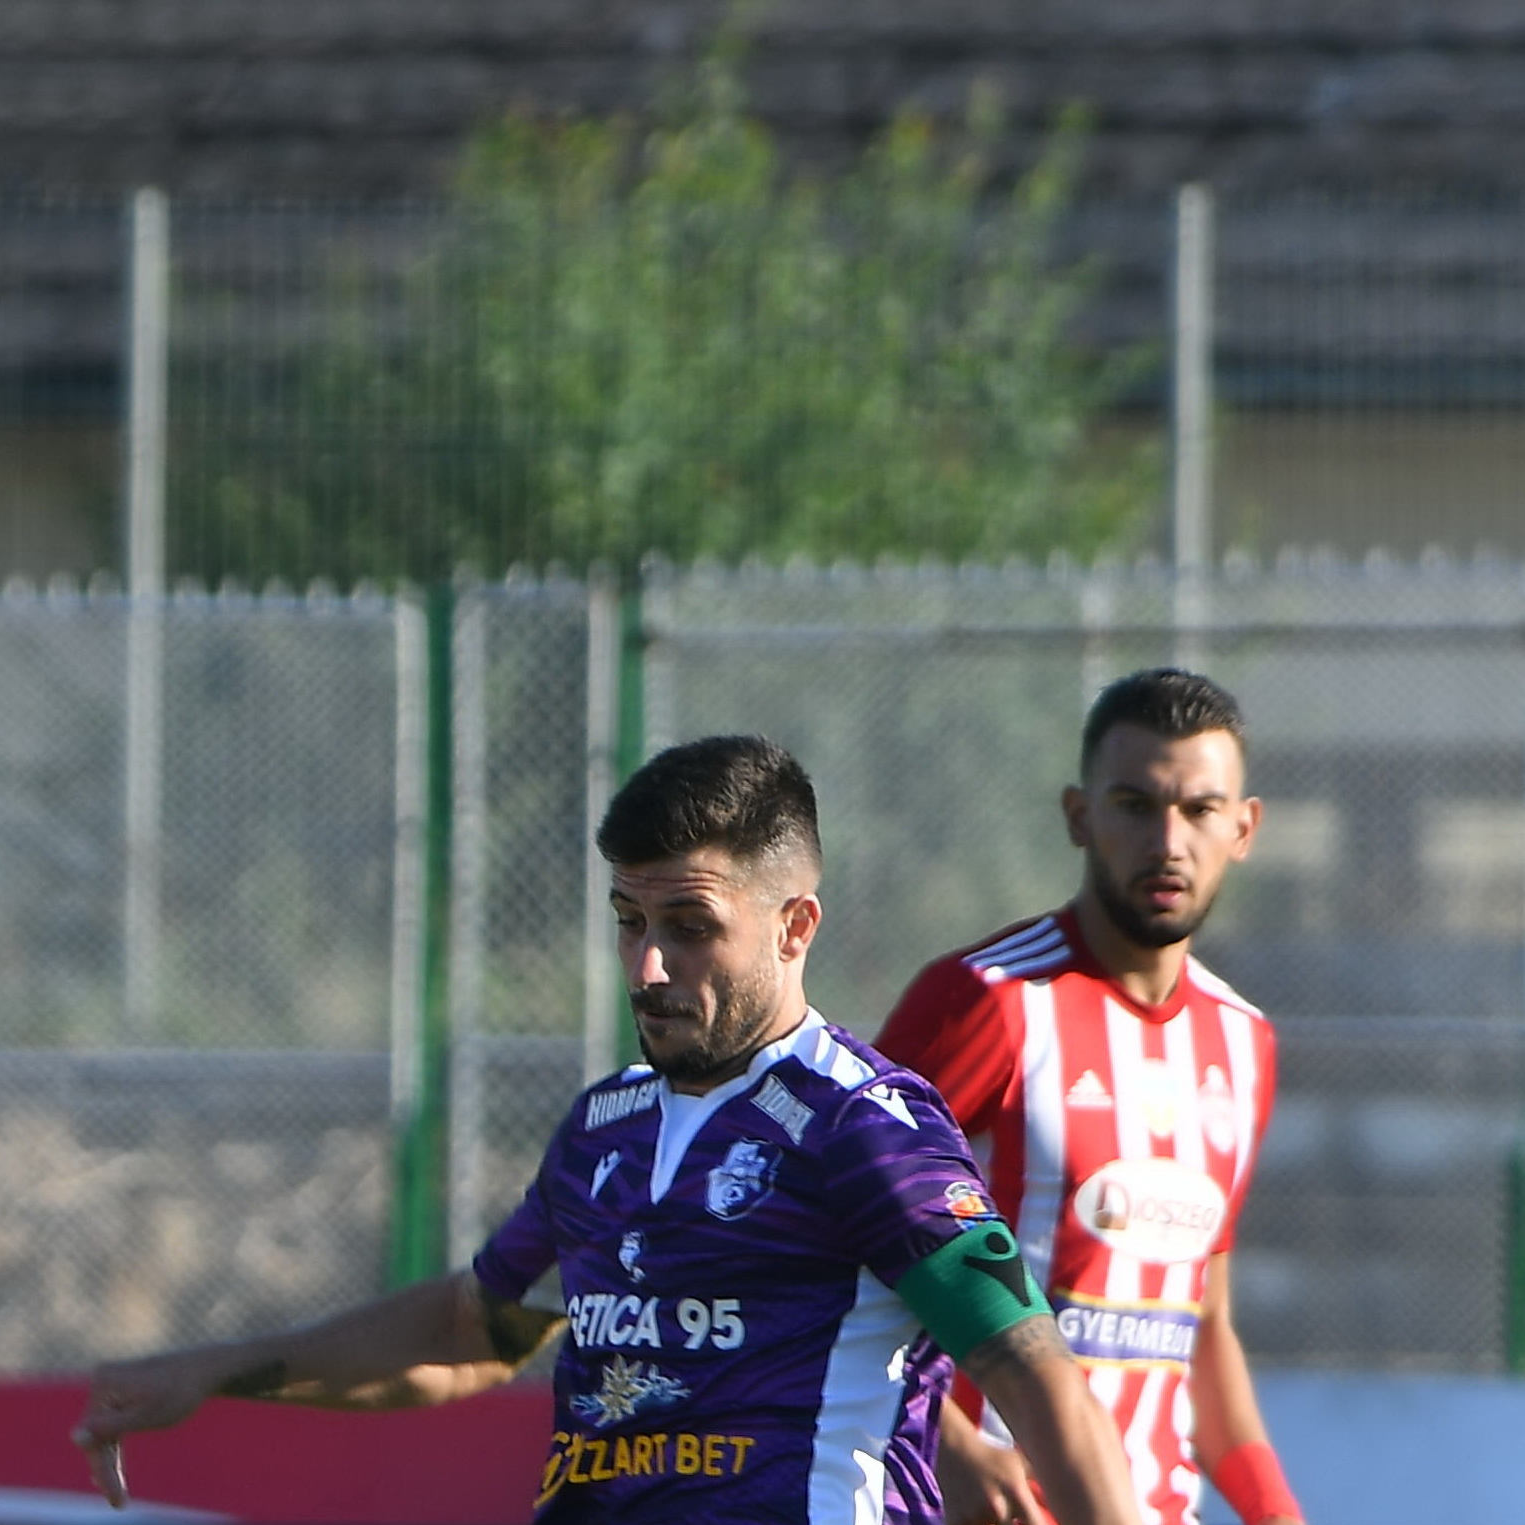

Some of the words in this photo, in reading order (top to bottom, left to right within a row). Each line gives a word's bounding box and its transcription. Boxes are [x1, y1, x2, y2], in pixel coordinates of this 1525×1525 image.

[568, 1294, 662, 1348] GETICA
[677, 1297, 745, 1350] 95
[675, 1433, 756, 1476] BET
